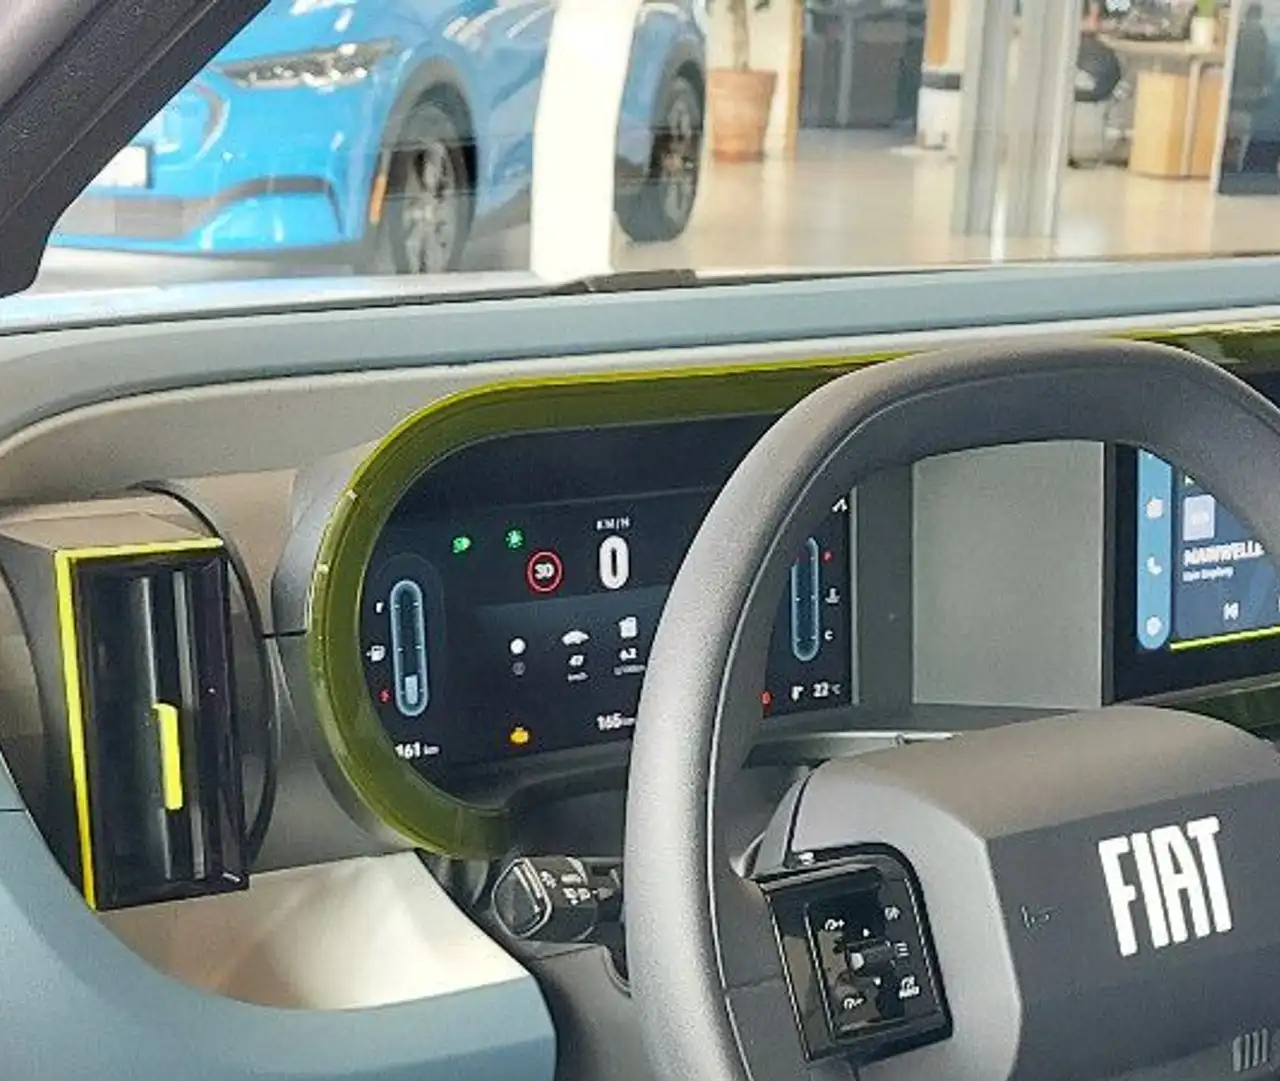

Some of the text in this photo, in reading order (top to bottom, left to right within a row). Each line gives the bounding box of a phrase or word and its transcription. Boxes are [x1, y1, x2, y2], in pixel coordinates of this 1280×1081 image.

[599, 535, 629, 589] 0
[395, 742, 421, 760] 161
[1097, 816, 1233, 957] FIAT
